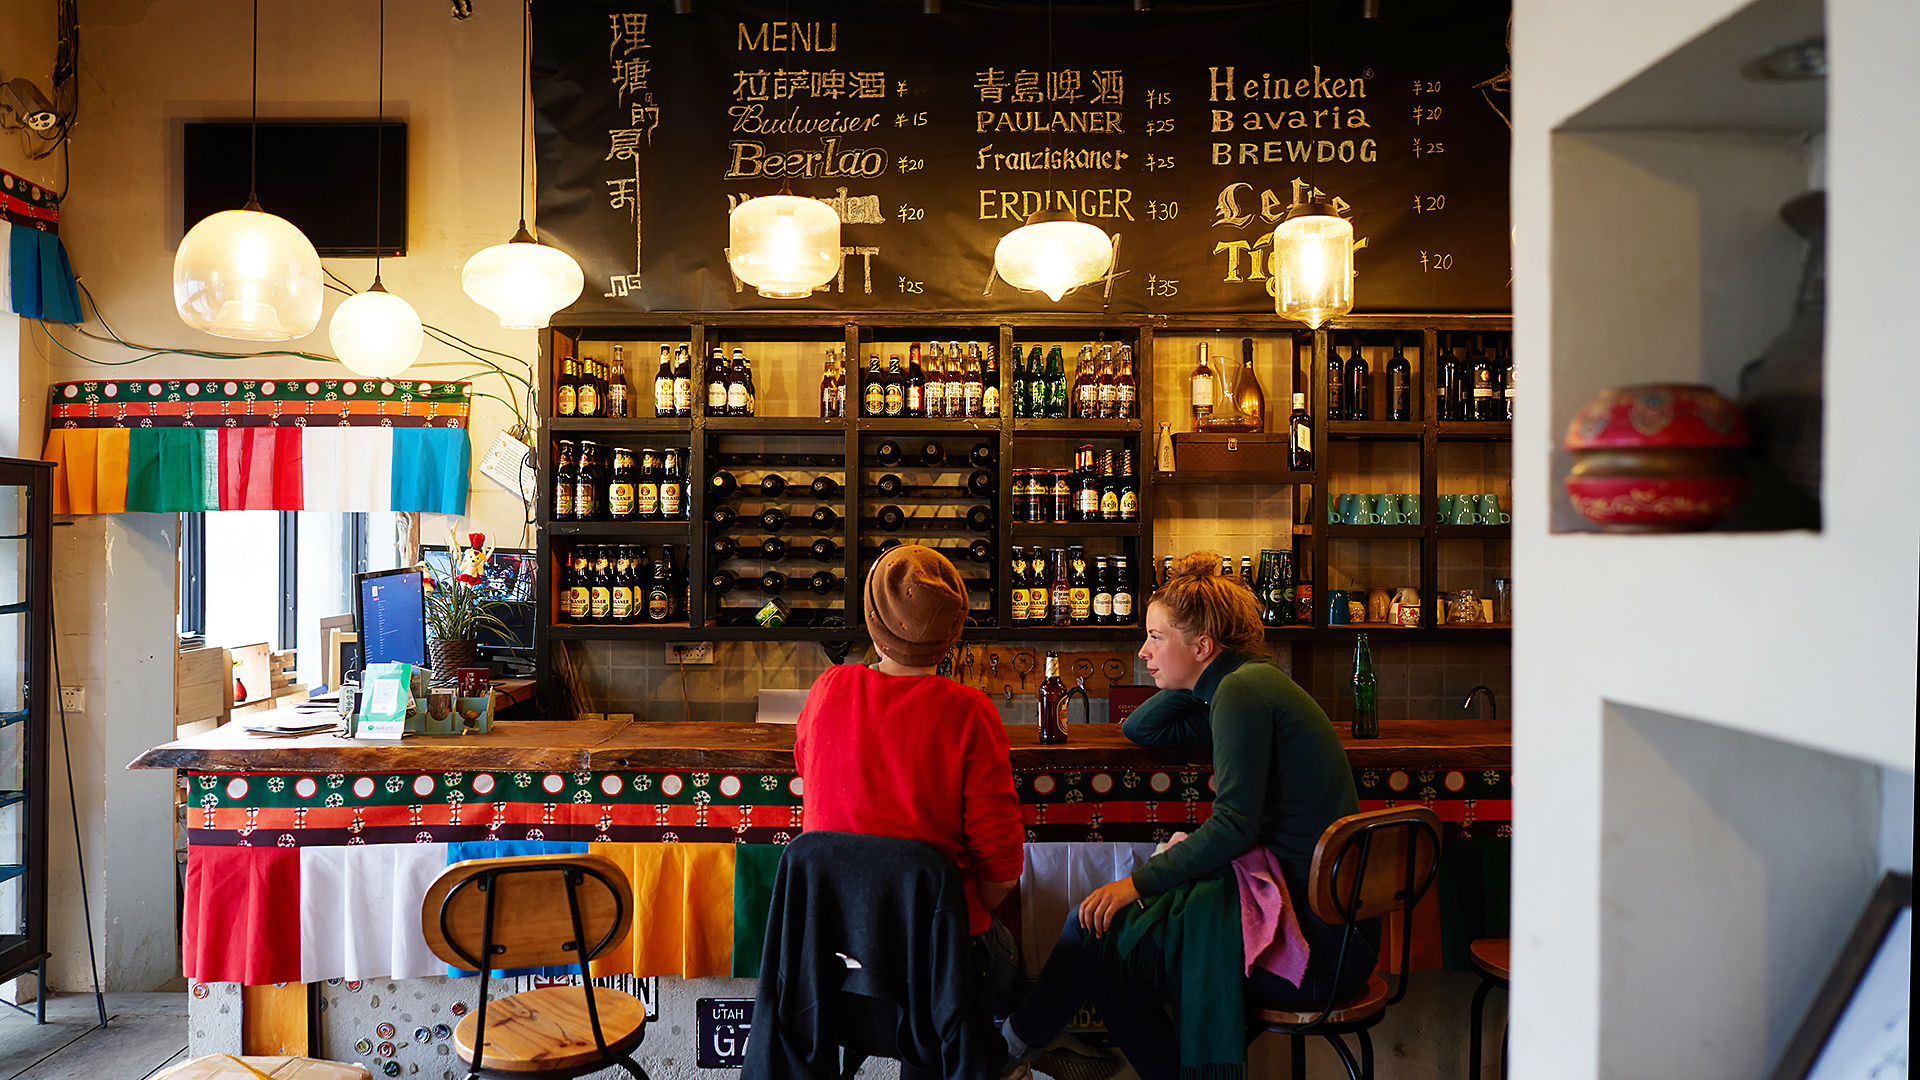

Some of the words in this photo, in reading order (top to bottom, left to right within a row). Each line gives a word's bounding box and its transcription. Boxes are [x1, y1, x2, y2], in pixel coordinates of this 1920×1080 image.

[738, 22, 837, 52] MENU
[733, 69, 886, 102] 拉萨啤酒
[728, 104, 882, 134] Budweiser
[976, 110, 1126, 134] PAULANER
[1211, 106, 1371, 132] Bavaria
[976, 143, 1129, 171] Franziskaner
[1212, 138, 1377, 165] BREWDOG
[979, 188, 1136, 221] ERDINGER
[712, 1008, 744, 1020] UTAH
